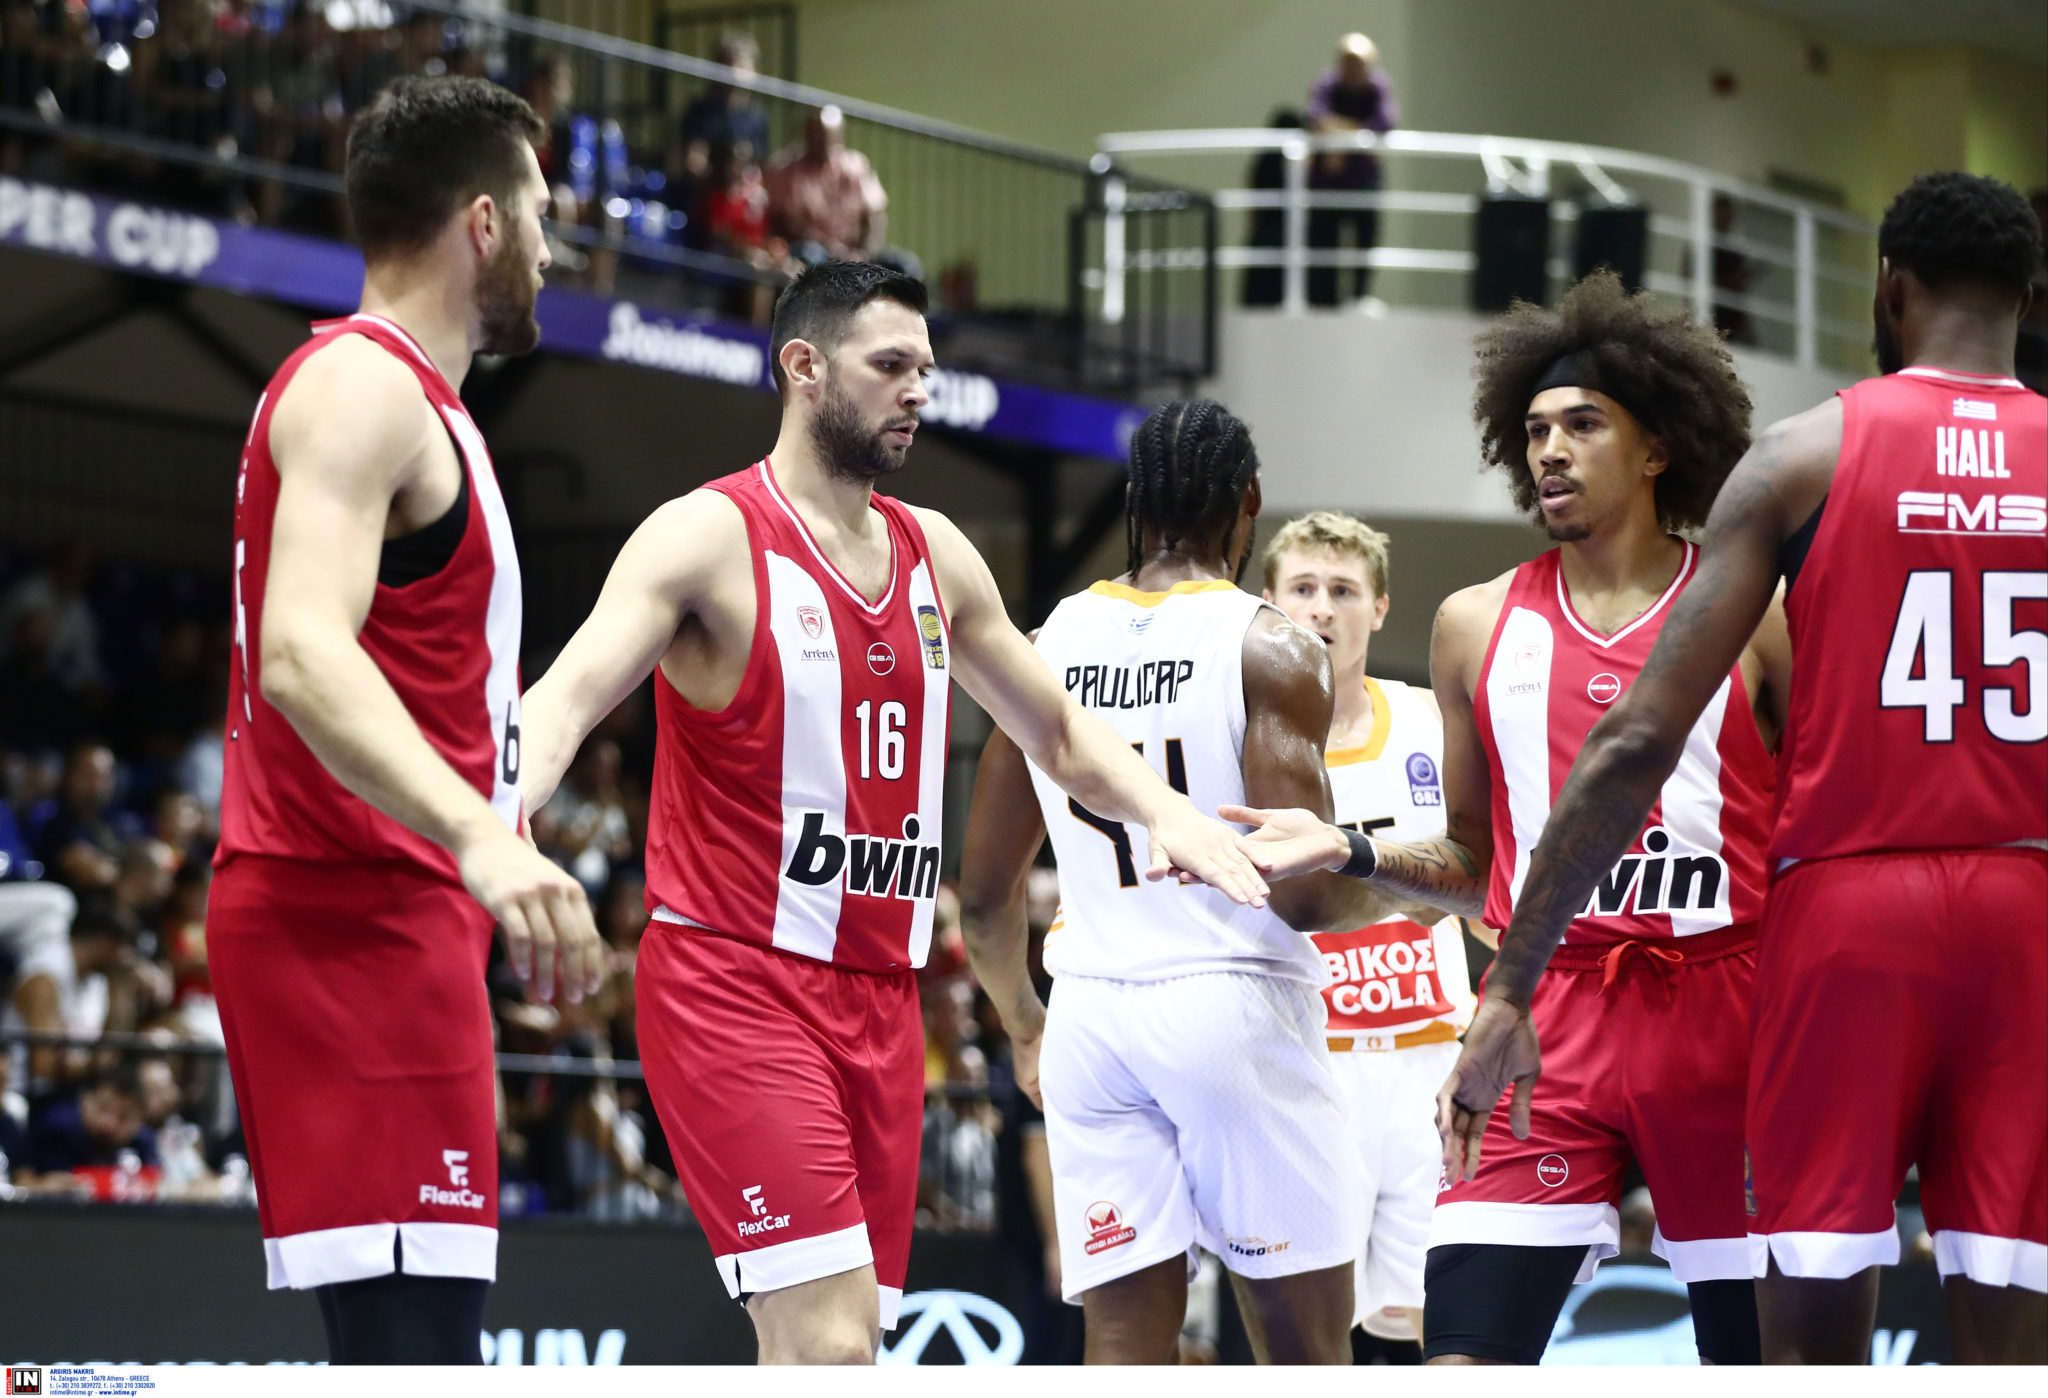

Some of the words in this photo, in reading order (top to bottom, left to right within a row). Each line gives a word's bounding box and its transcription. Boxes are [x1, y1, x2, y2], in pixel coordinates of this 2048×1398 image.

[108, 202, 220, 280] CUP
[1936, 426, 2011, 478] HALL
[1897, 491, 2048, 531] FMS
[1878, 568, 2048, 744] 45
[1066, 660, 1194, 709] PAULICAP
[855, 700, 907, 780] 16
[785, 812, 940, 900] bwin
[1576, 830, 1722, 912] win
[1321, 938, 1436, 984] ΒΙΚΟΣ
[1332, 973, 1437, 1015] COLA
[1540, 1166, 1566, 1174] GSA
[419, 1184, 486, 1209] FlexCar
[737, 1214, 791, 1237] FlexCar
[1229, 1240, 1291, 1257] theocar
